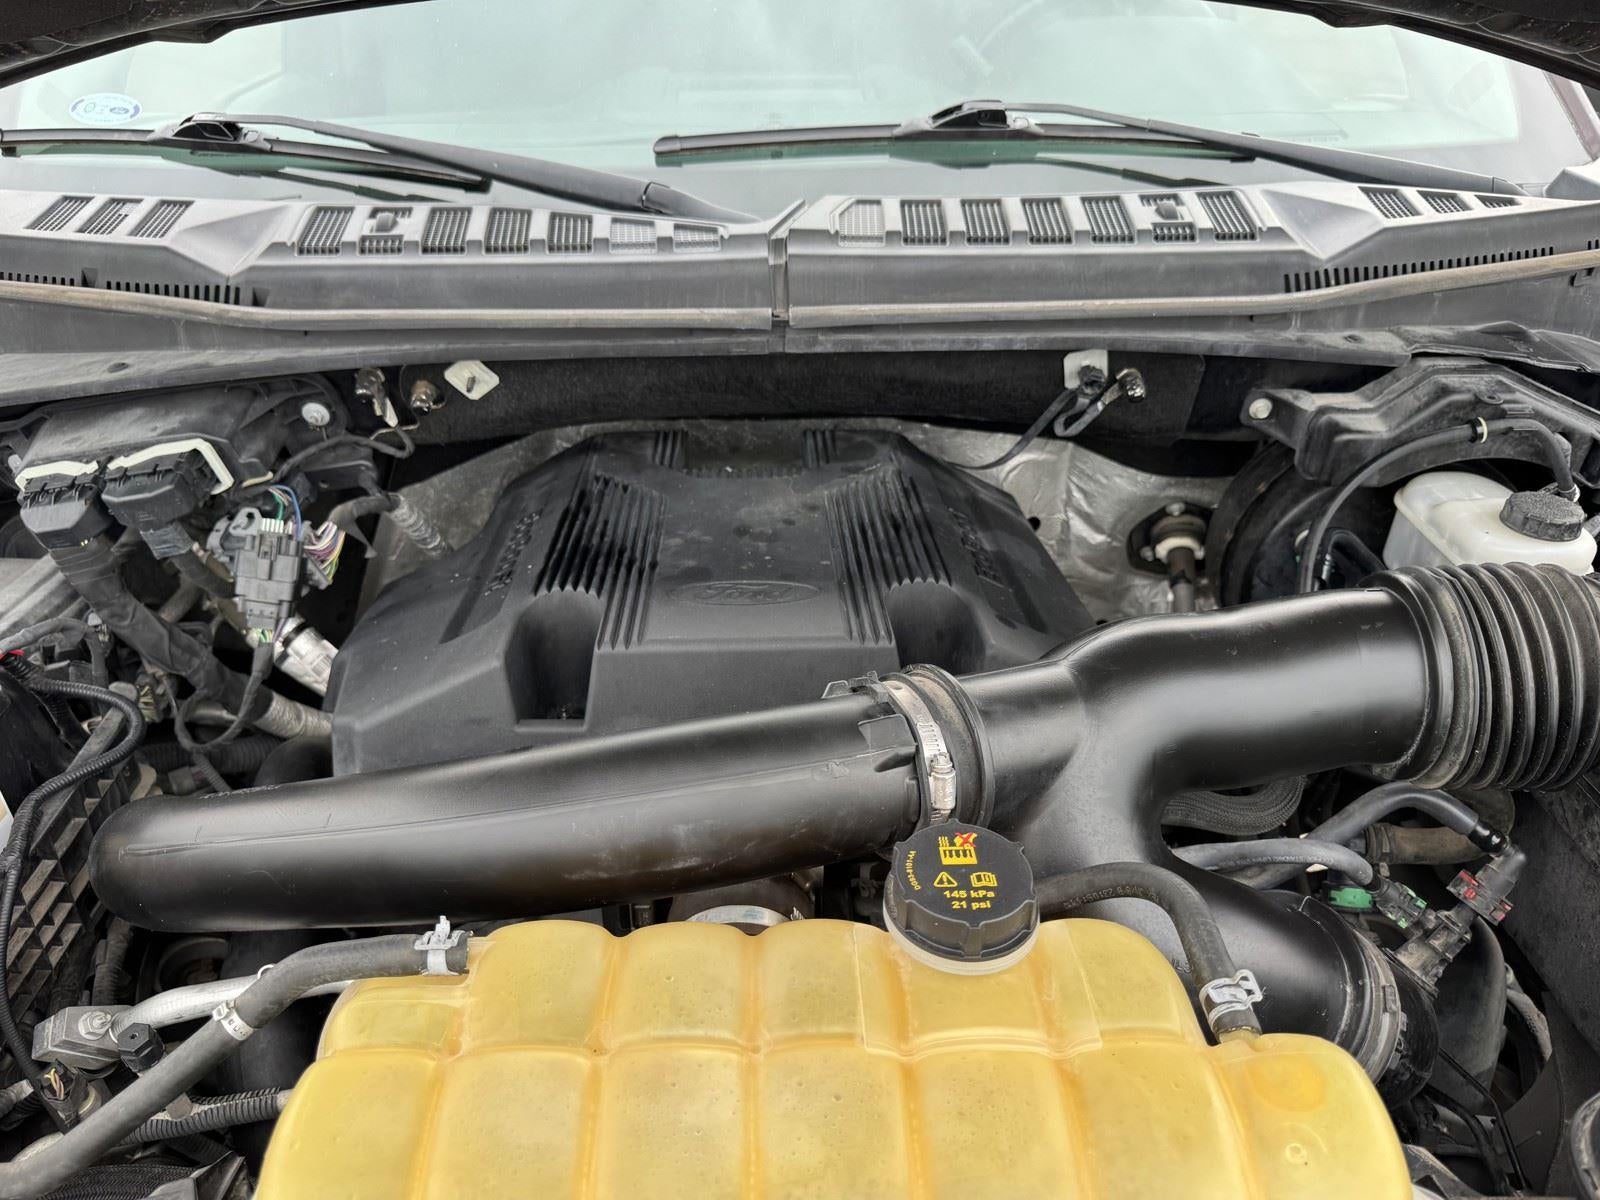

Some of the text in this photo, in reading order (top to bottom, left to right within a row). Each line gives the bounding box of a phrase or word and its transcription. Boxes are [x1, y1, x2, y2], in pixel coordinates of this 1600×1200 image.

[943, 890, 996, 899] 145 kPa
[951, 900, 991, 911] 21 psi
